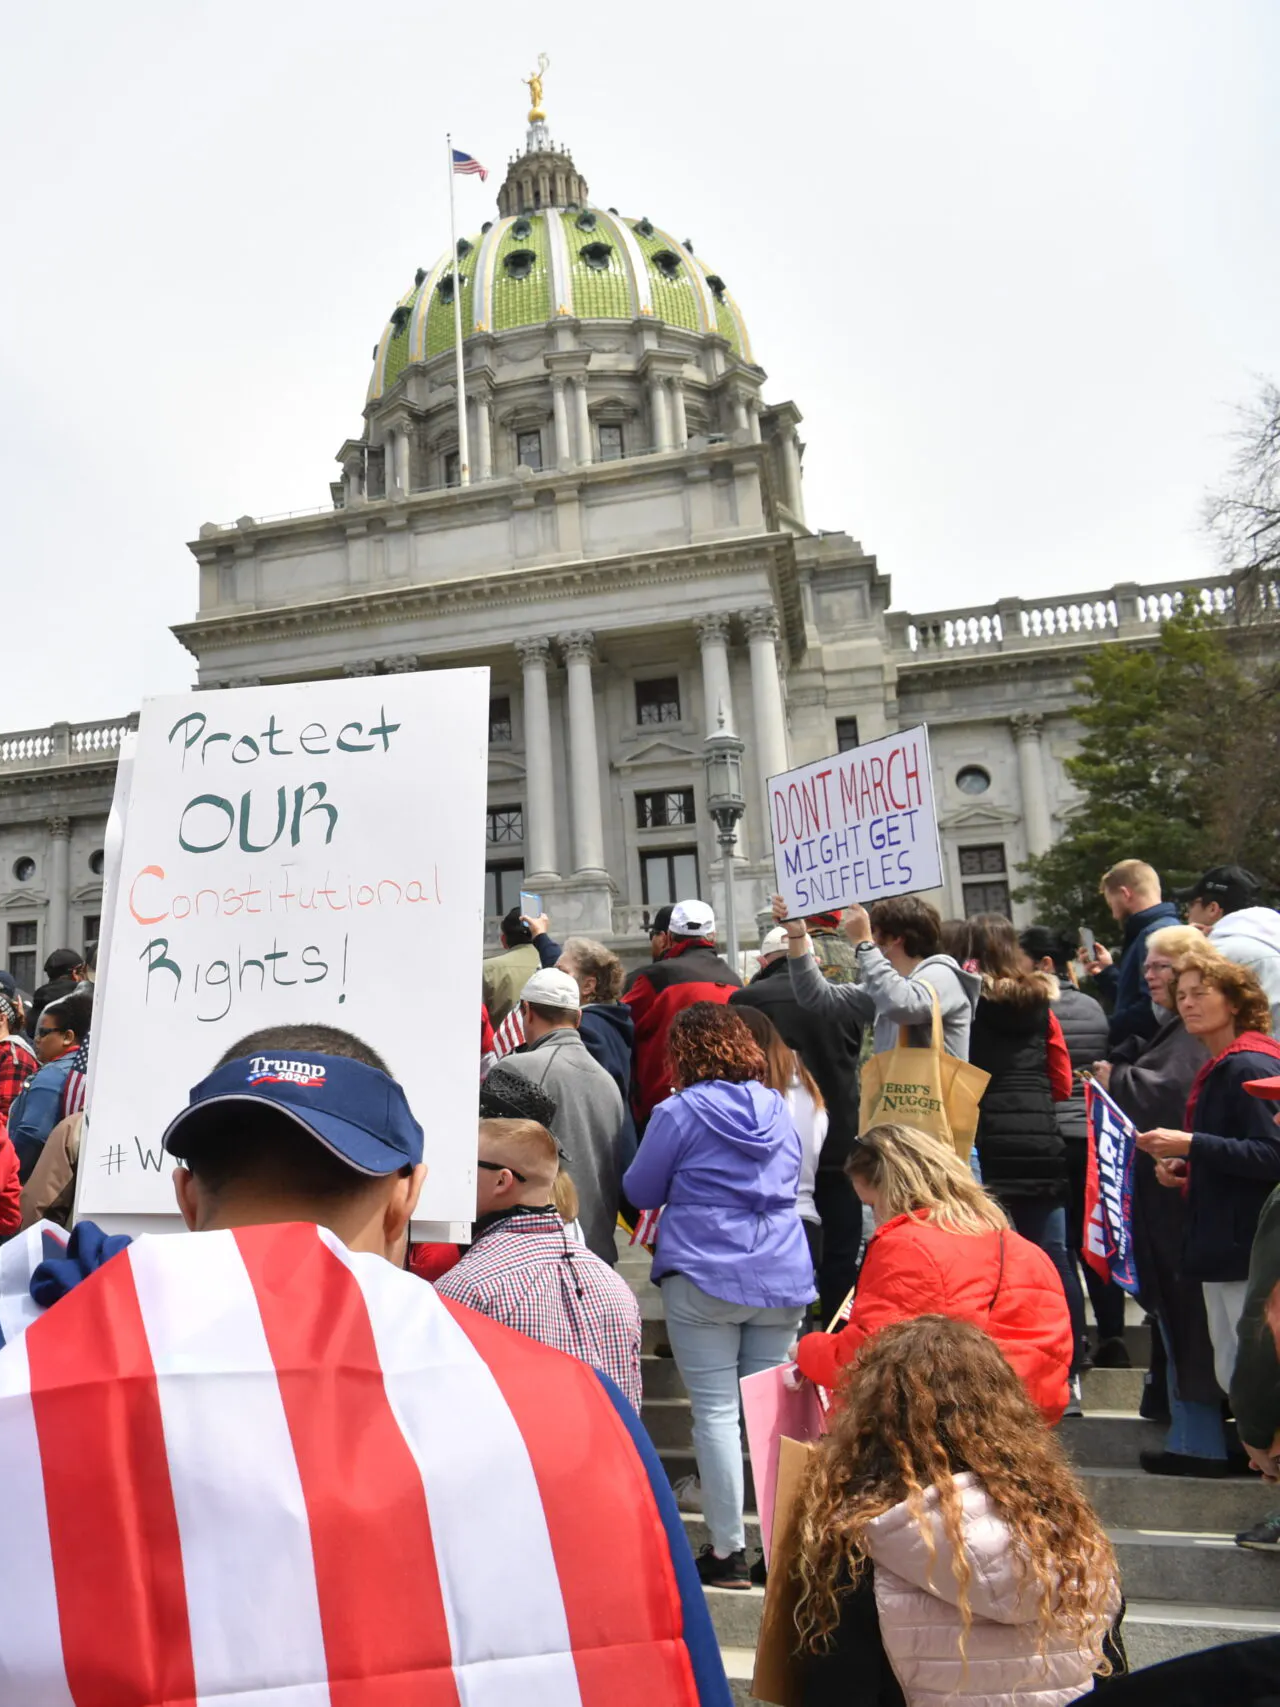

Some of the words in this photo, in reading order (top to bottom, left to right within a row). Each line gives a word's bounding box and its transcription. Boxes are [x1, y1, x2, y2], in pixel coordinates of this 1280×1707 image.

[168, 704, 402, 771] Protect
[179, 780, 338, 854] OUR
[773, 769, 833, 845] DONT
[838, 743, 922, 824] MARCH
[784, 824, 861, 878] MIGHT
[869, 809, 919, 850] GET
[128, 863, 444, 926] Constitutional
[795, 850, 913, 907] SNIFFLES
[138, 933, 350, 1022] Rights!
[249, 1056, 326, 1079] Trump
[277, 1071, 309, 1084] 2020
[885, 1082, 931, 1095] ERRY'S
